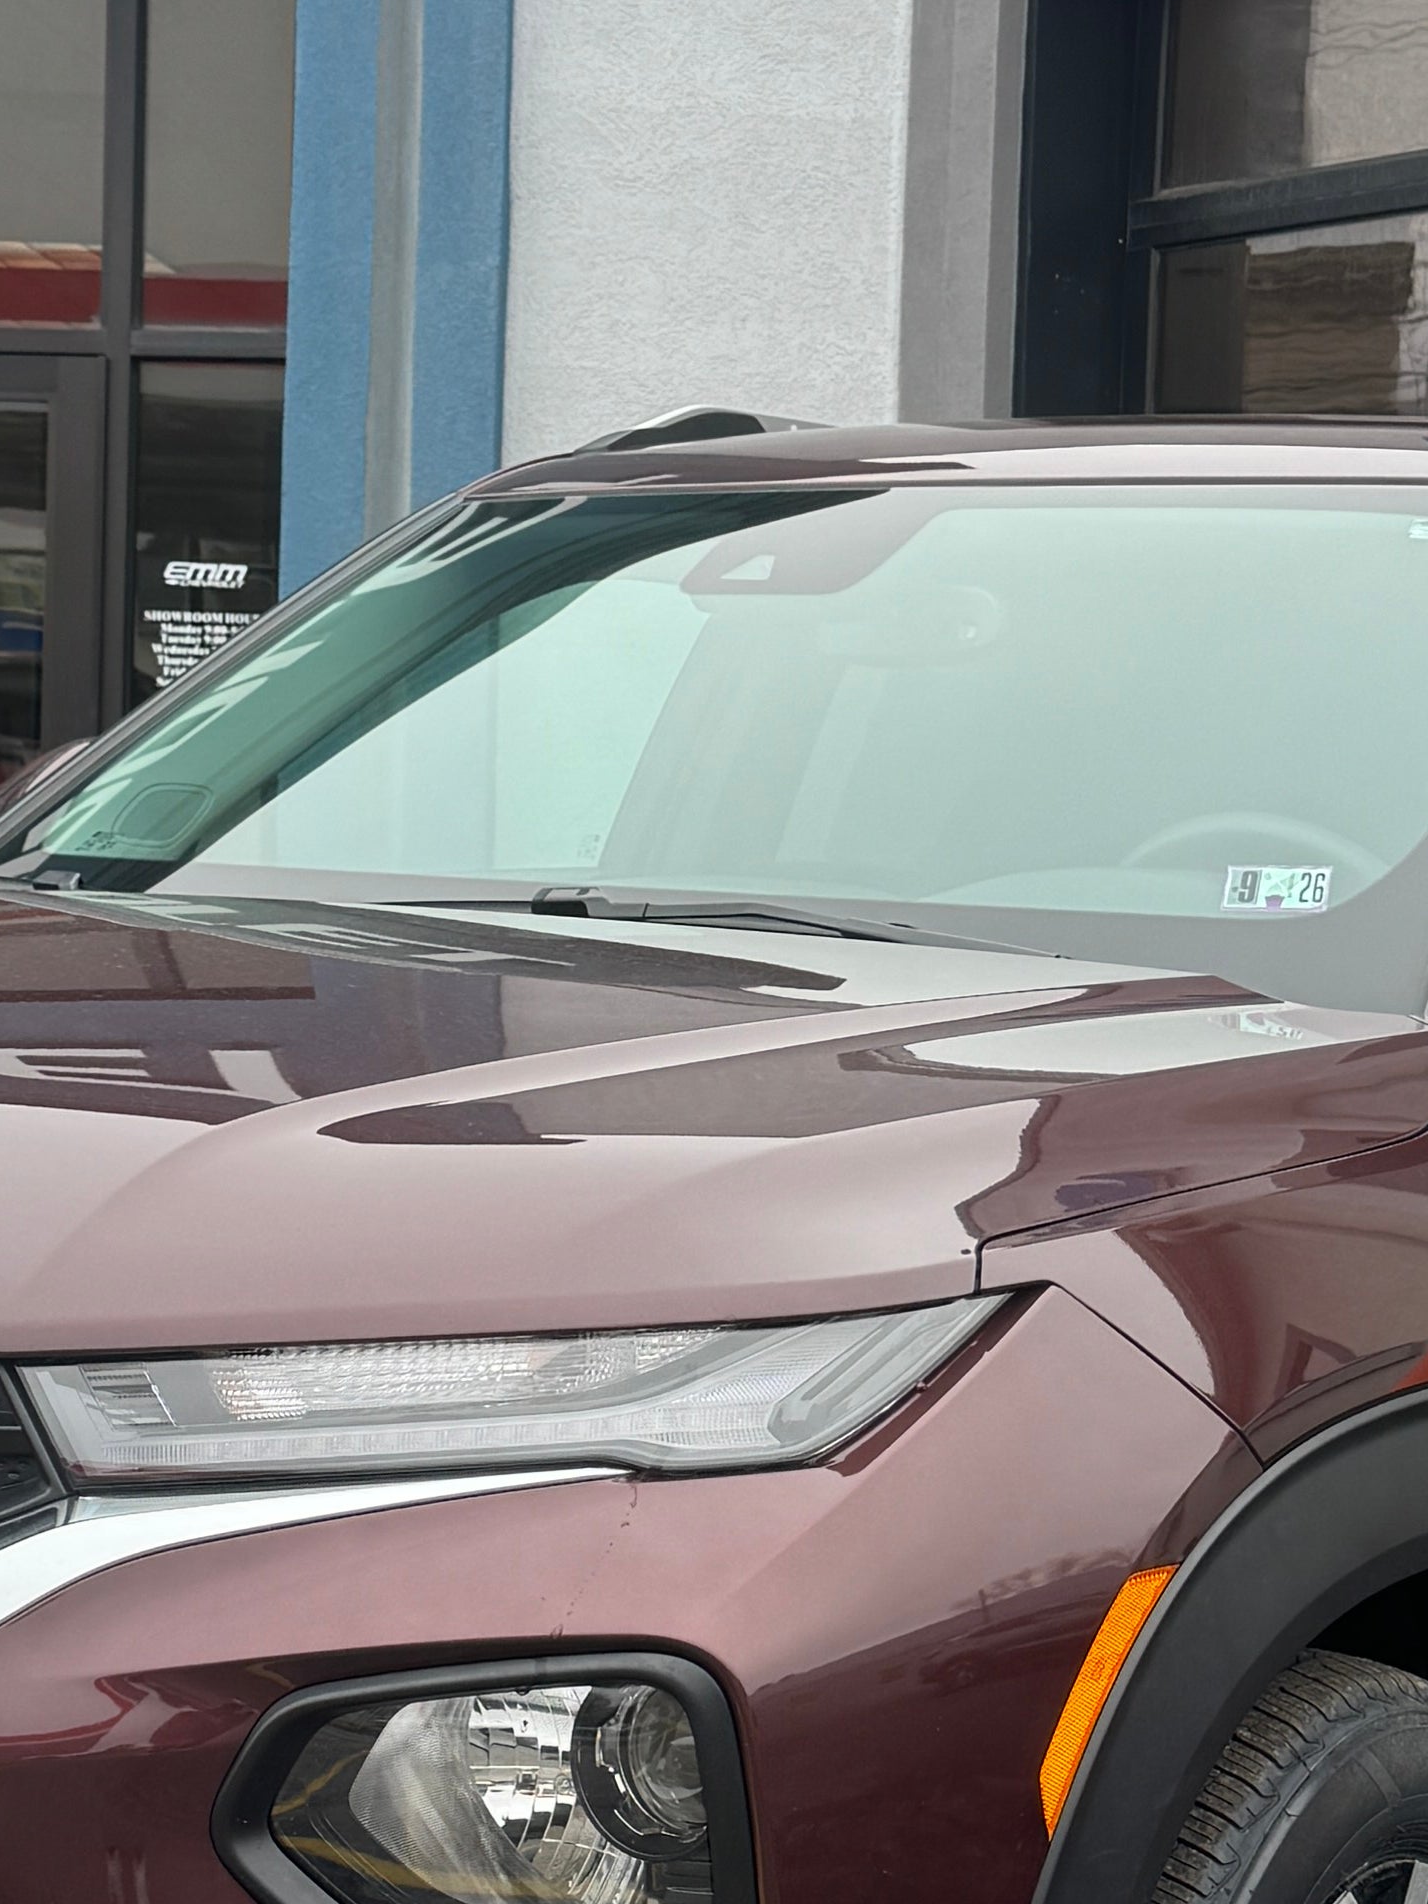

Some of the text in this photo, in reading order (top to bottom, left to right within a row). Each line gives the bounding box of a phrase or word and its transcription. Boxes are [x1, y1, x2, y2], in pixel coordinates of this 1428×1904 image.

[143, 610, 223, 624] SHOWROOM
[1237, 870, 1325, 903] 9 26
